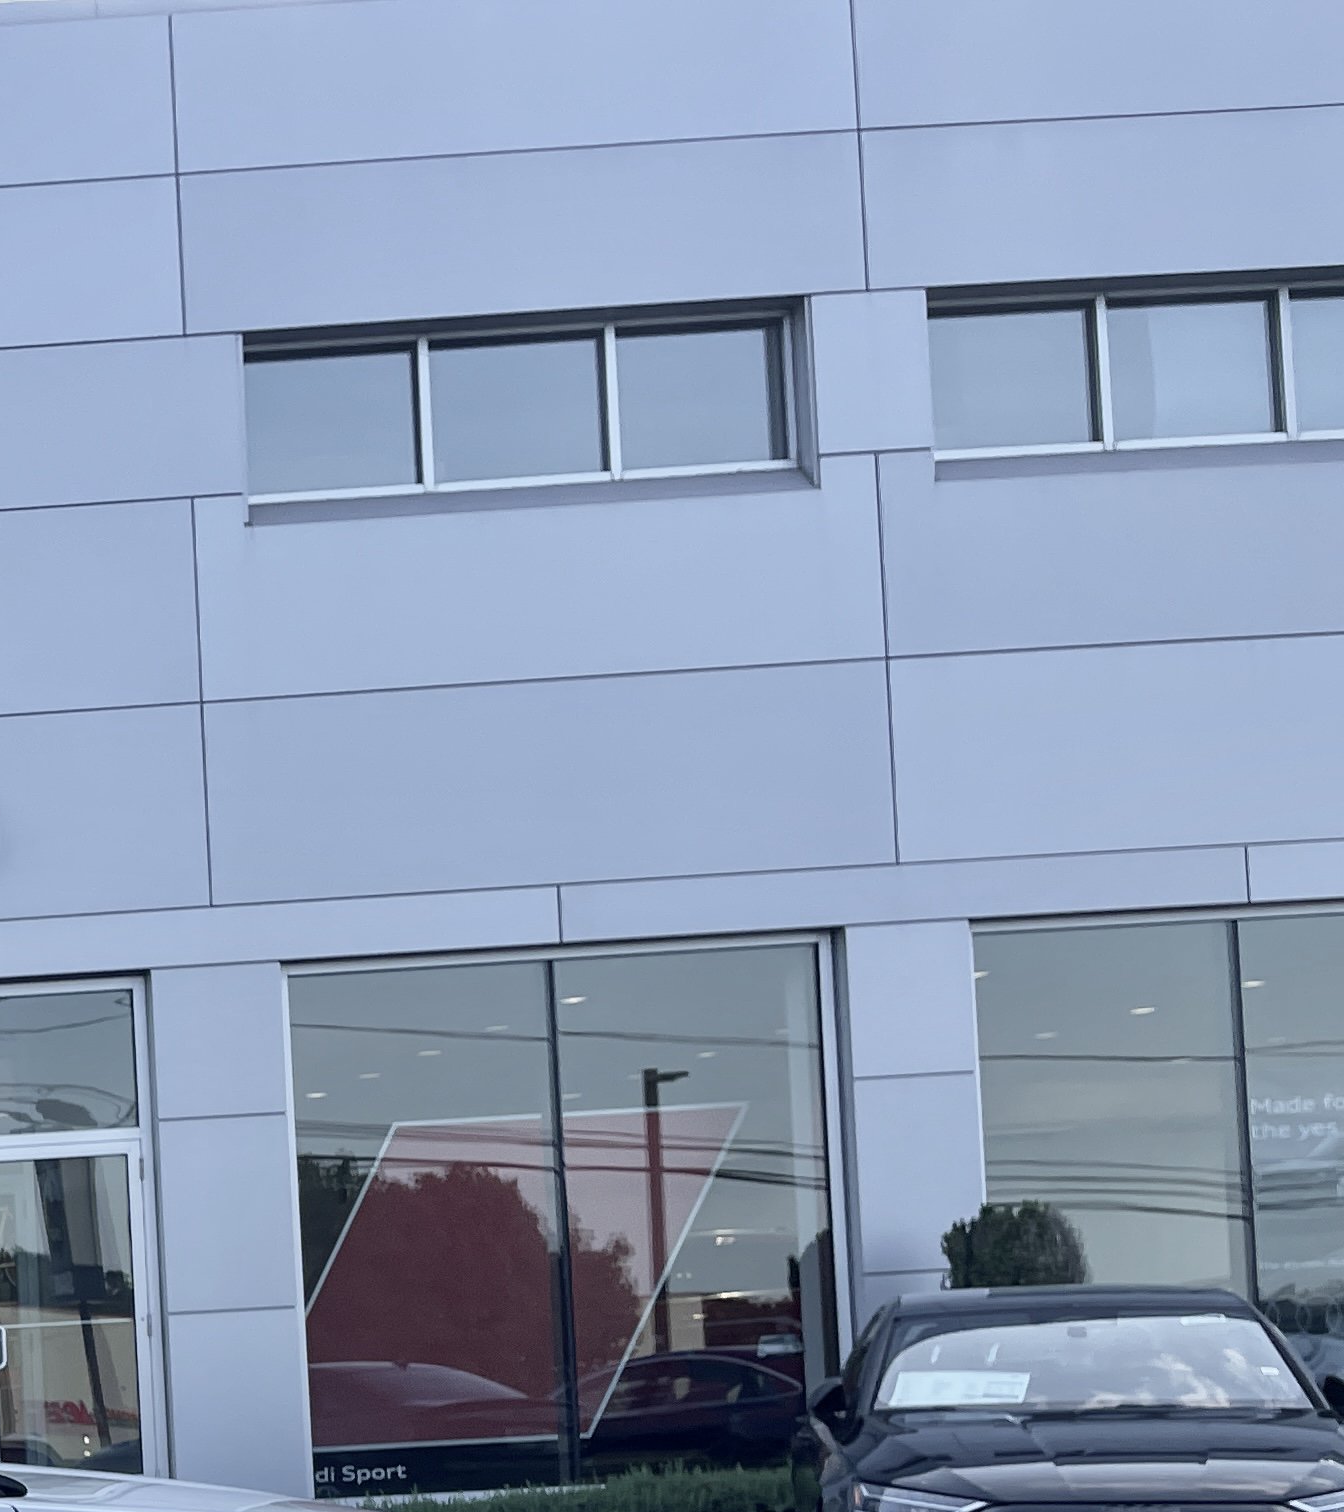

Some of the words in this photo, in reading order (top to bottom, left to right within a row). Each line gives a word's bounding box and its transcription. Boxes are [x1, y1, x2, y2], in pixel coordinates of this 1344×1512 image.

[1250, 1096, 1316, 1115] Made
[315, 1467, 335, 1483] di
[342, 1464, 408, 1486] Sport
